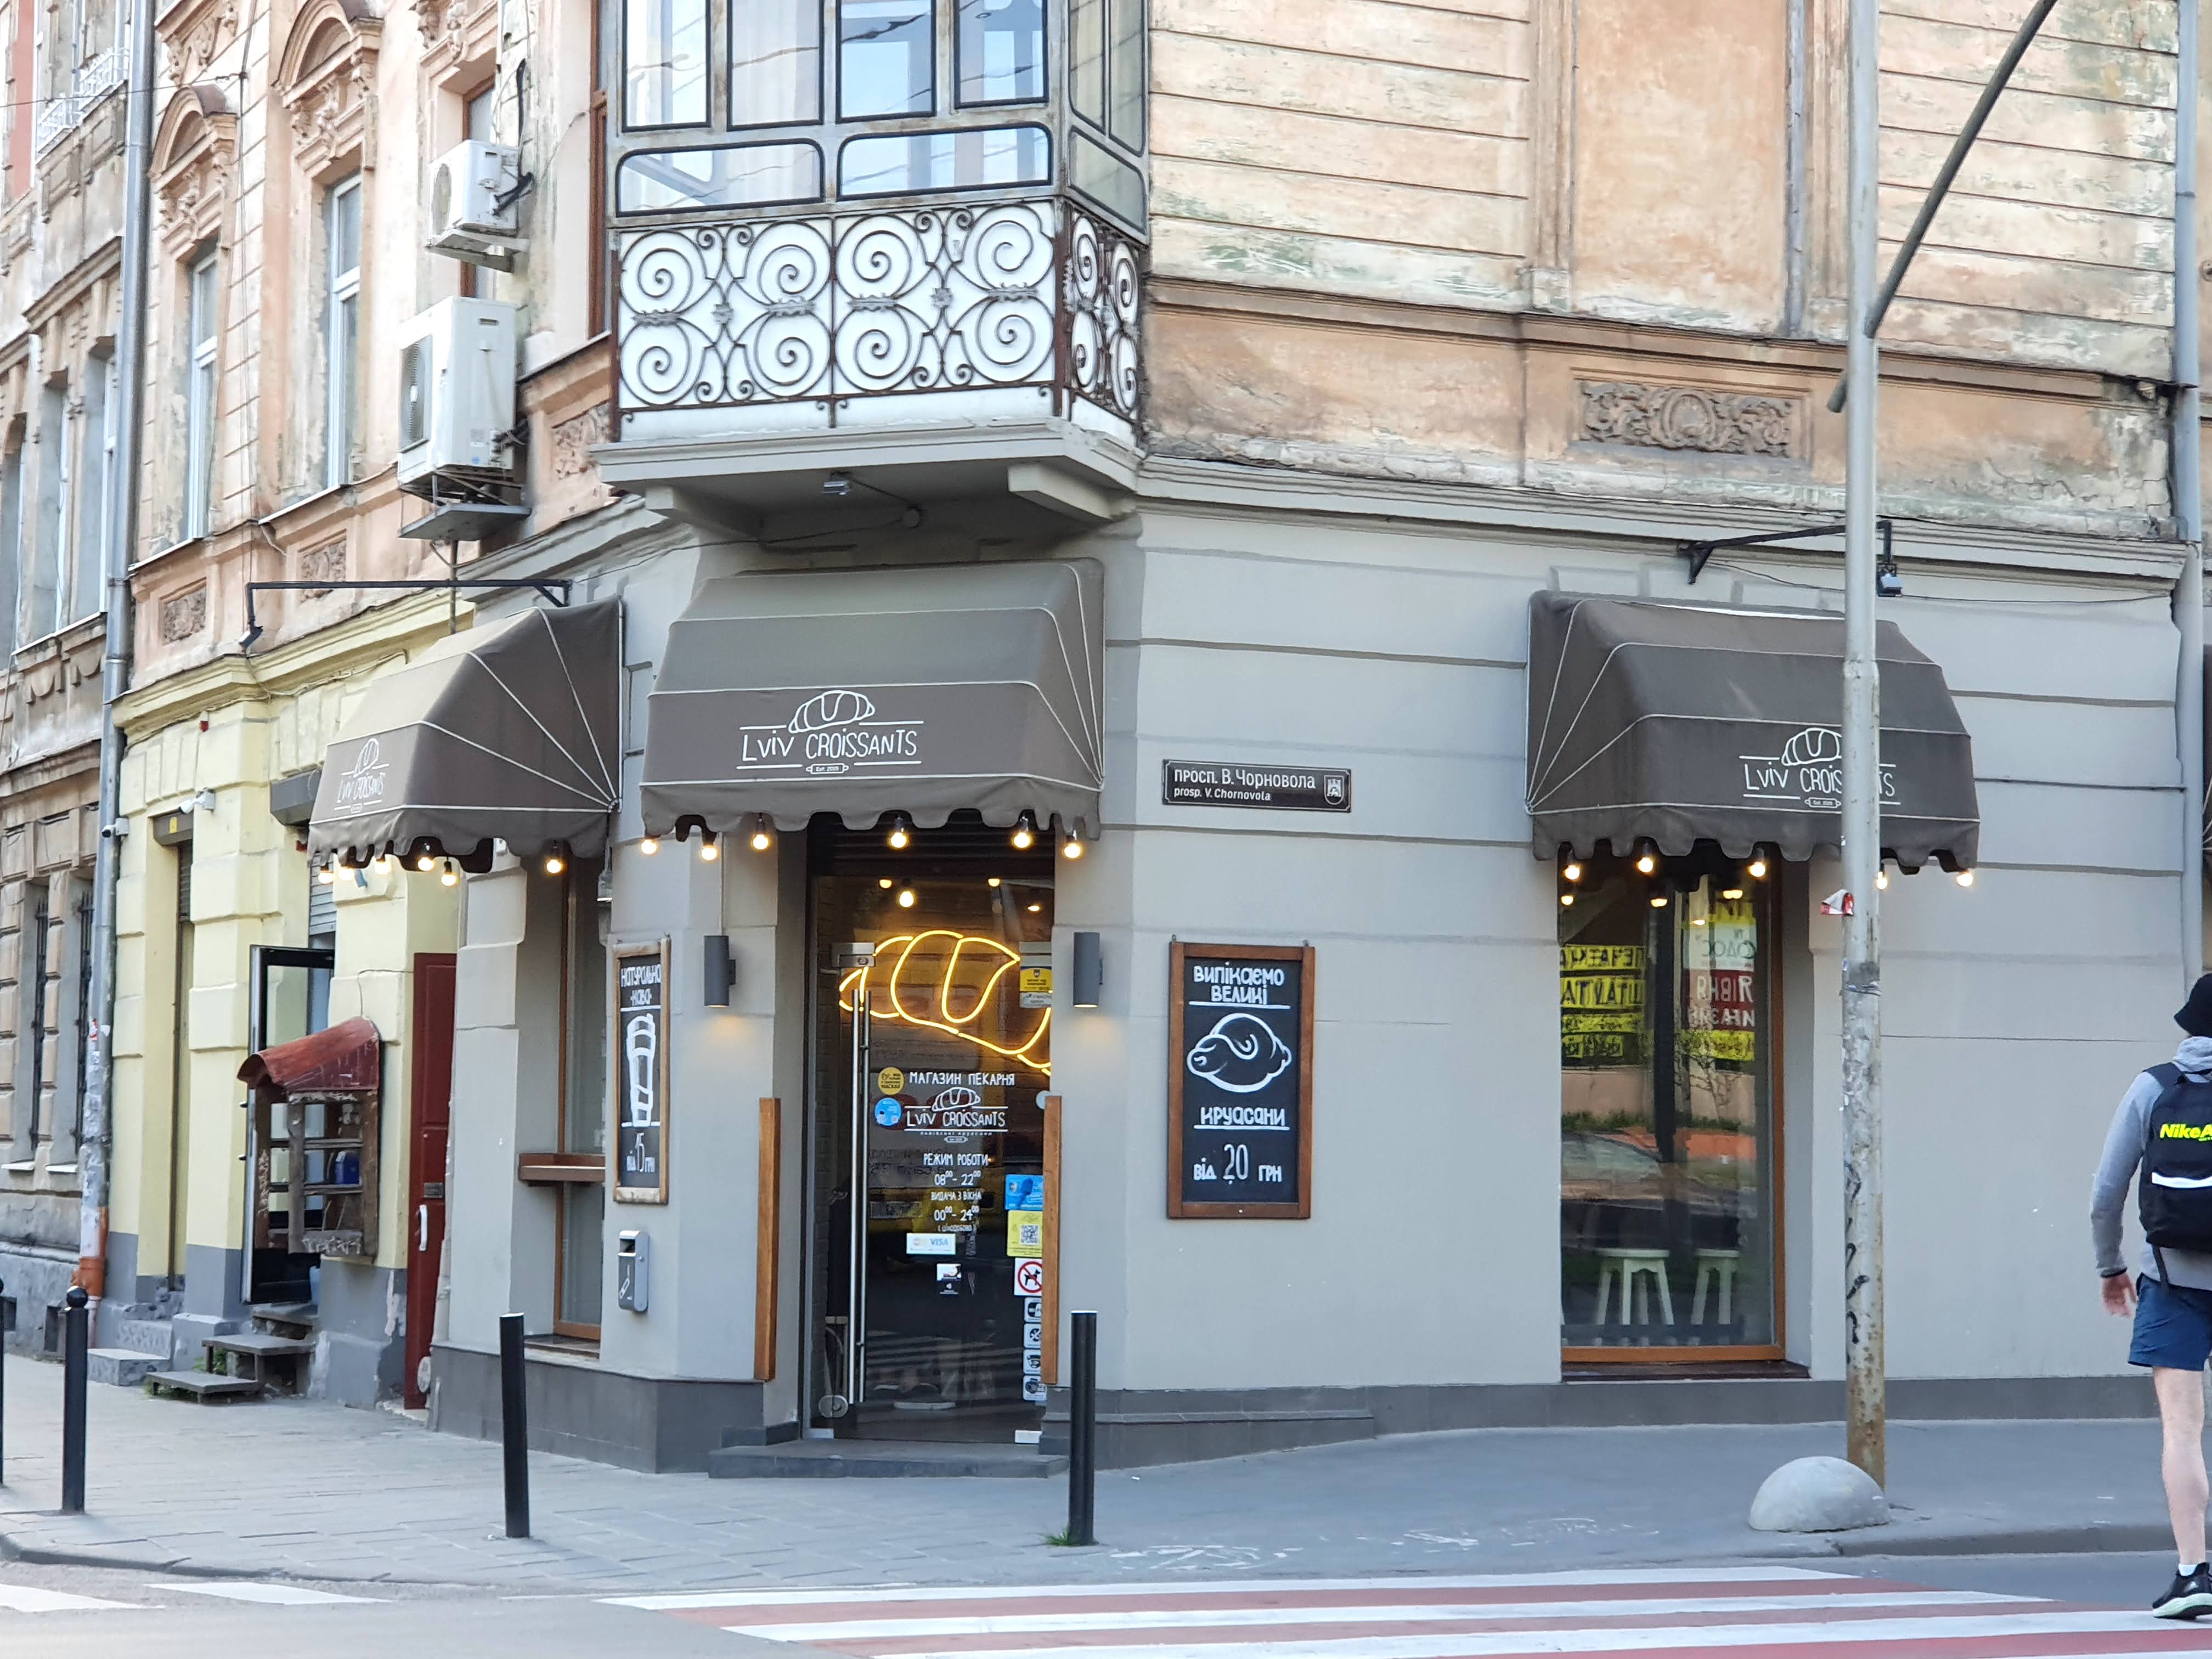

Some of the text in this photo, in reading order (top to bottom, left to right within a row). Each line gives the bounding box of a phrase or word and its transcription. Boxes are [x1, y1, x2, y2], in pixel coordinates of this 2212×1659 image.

[1221, 769, 1234, 785] В.
[1235, 769, 1316, 789] Чорновола
[1173, 787, 1271, 802] prosp. V. Chornovola
[909, 1072, 961, 1085] МАГАЗИН
[968, 1073, 1014, 1086] ПЕКАРНЯ
[923, 1153, 953, 1166] РЕЖИМ
[957, 1153, 989, 1166] РОБОТИ
[1223, 1144, 1248, 1183] 20
